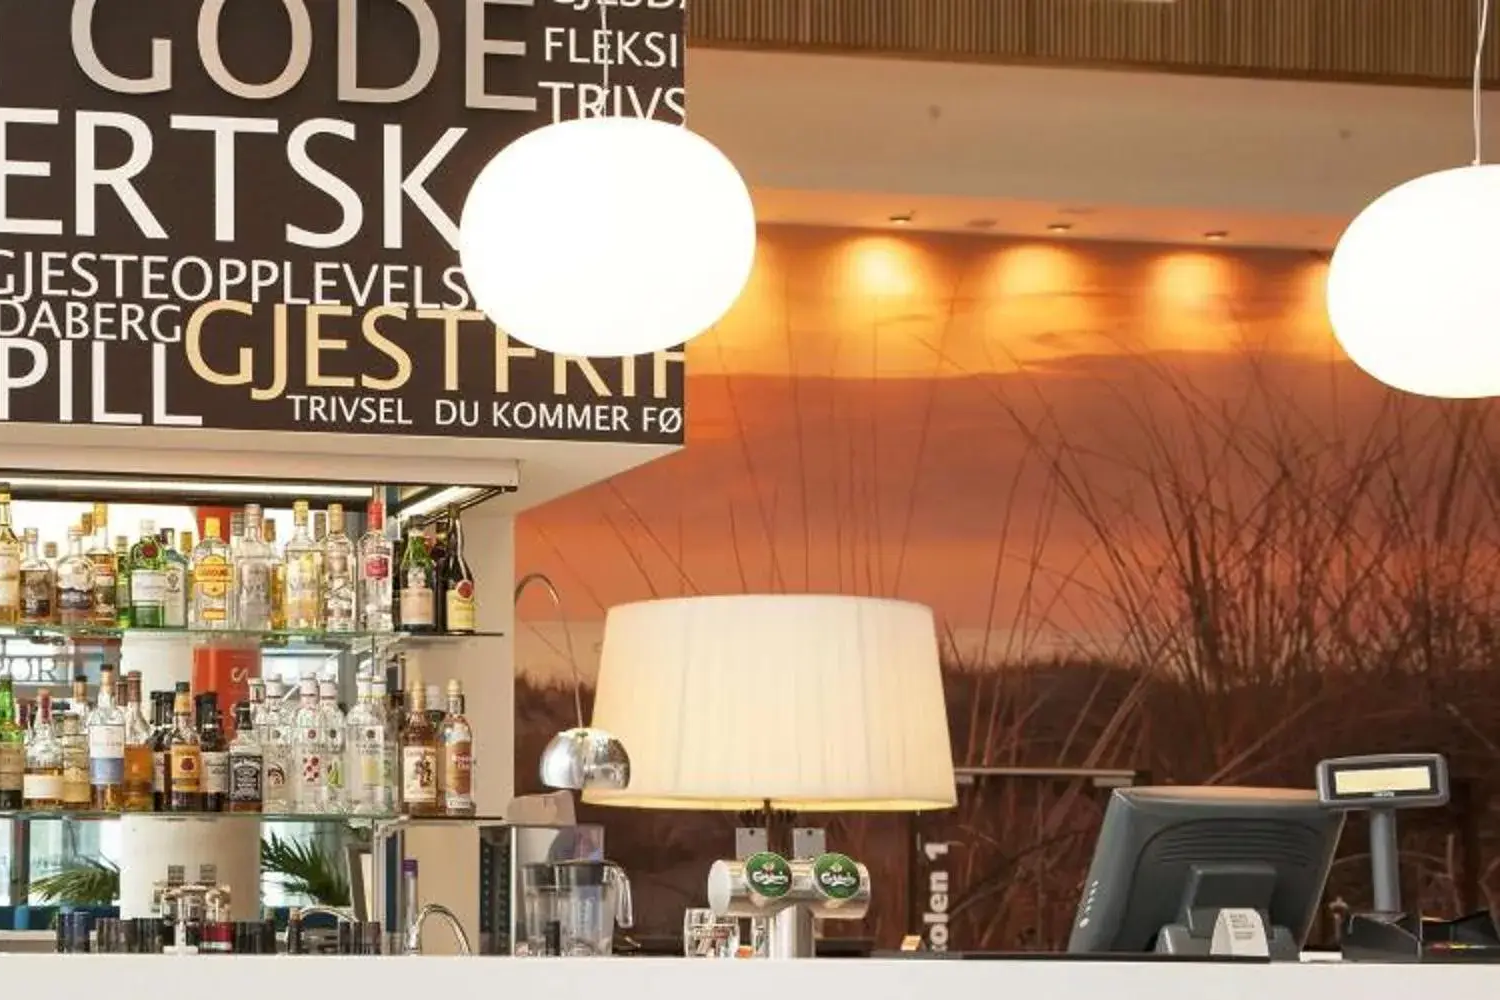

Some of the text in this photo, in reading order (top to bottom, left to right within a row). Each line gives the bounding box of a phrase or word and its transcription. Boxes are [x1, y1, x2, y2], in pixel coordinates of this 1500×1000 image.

[71, 0, 536, 111] GODE
[545, 27, 677, 67] FLEKSI
[285, 395, 413, 425] TRIVSEL
[435, 399, 682, 433] DU KOMMER FØ
